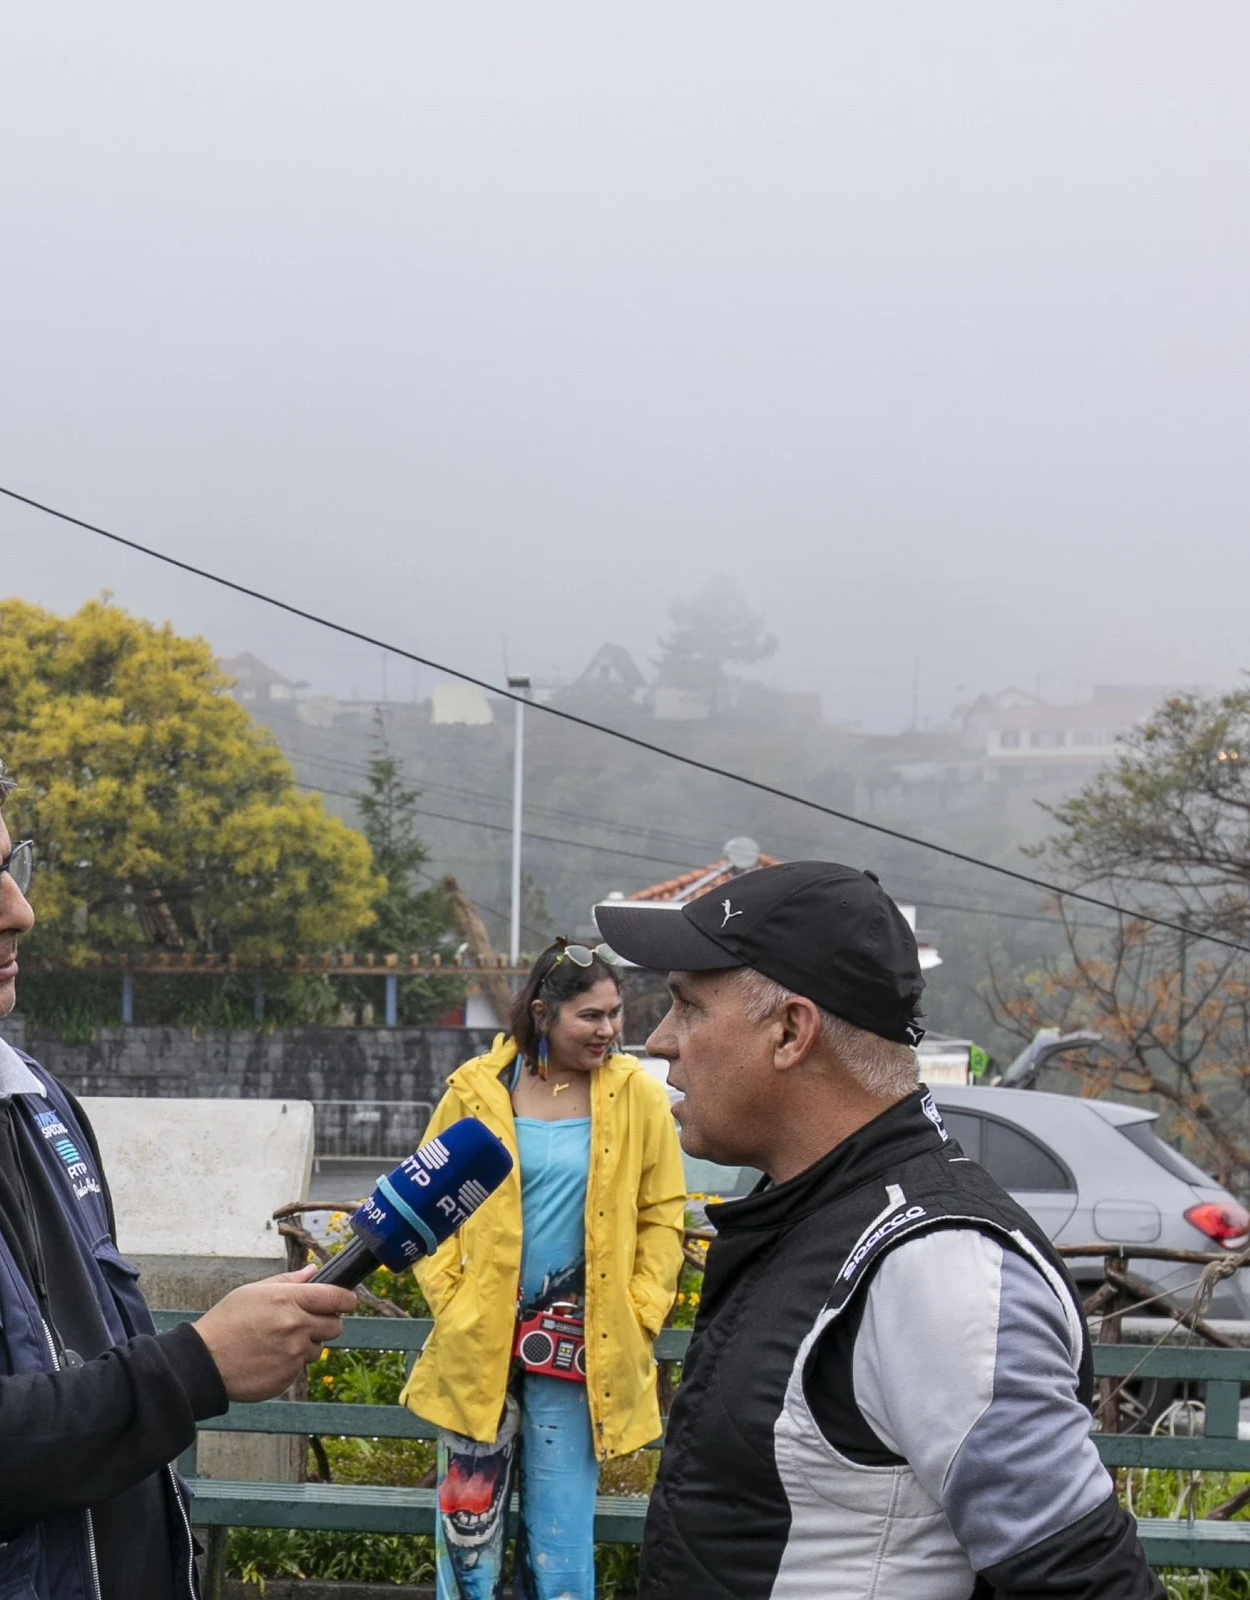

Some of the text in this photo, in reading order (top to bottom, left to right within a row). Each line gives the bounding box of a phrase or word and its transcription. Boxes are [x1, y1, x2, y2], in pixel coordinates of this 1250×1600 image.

[67, 1163, 88, 1179] RTP
[362, 1196, 387, 1224] tp.pt
[435, 1194, 469, 1228] RT
[842, 1205, 927, 1281] sparco
